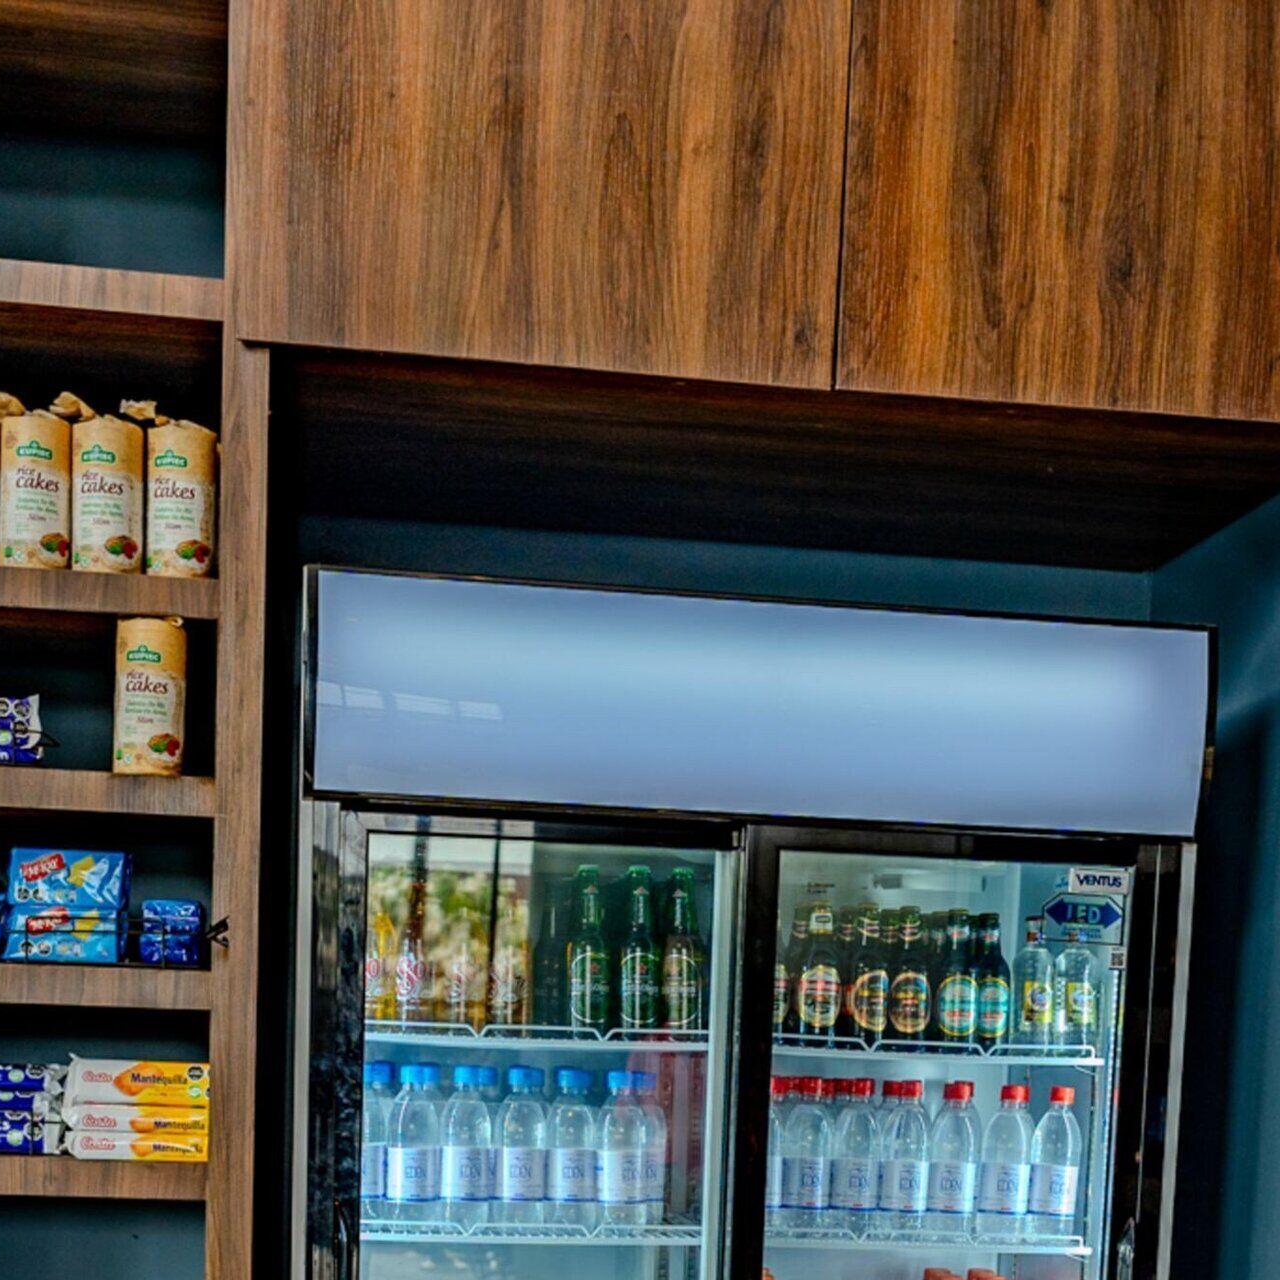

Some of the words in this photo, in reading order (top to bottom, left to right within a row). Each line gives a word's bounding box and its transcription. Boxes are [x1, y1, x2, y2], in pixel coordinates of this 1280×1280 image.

[17, 466, 36, 475] rice
[81, 470, 99, 480] rice
[15, 473, 60, 493] cakes
[81, 477, 124, 495] cakes
[154, 476, 171, 485] rice
[154, 482, 195, 499] cakes
[126, 670, 144, 680] rice
[126, 676, 168, 694] cakes
[1076, 874, 1122, 888] VENTUS
[131, 1073, 188, 1086] Mantequilla
[154, 1120, 205, 1131] Mantequilla
